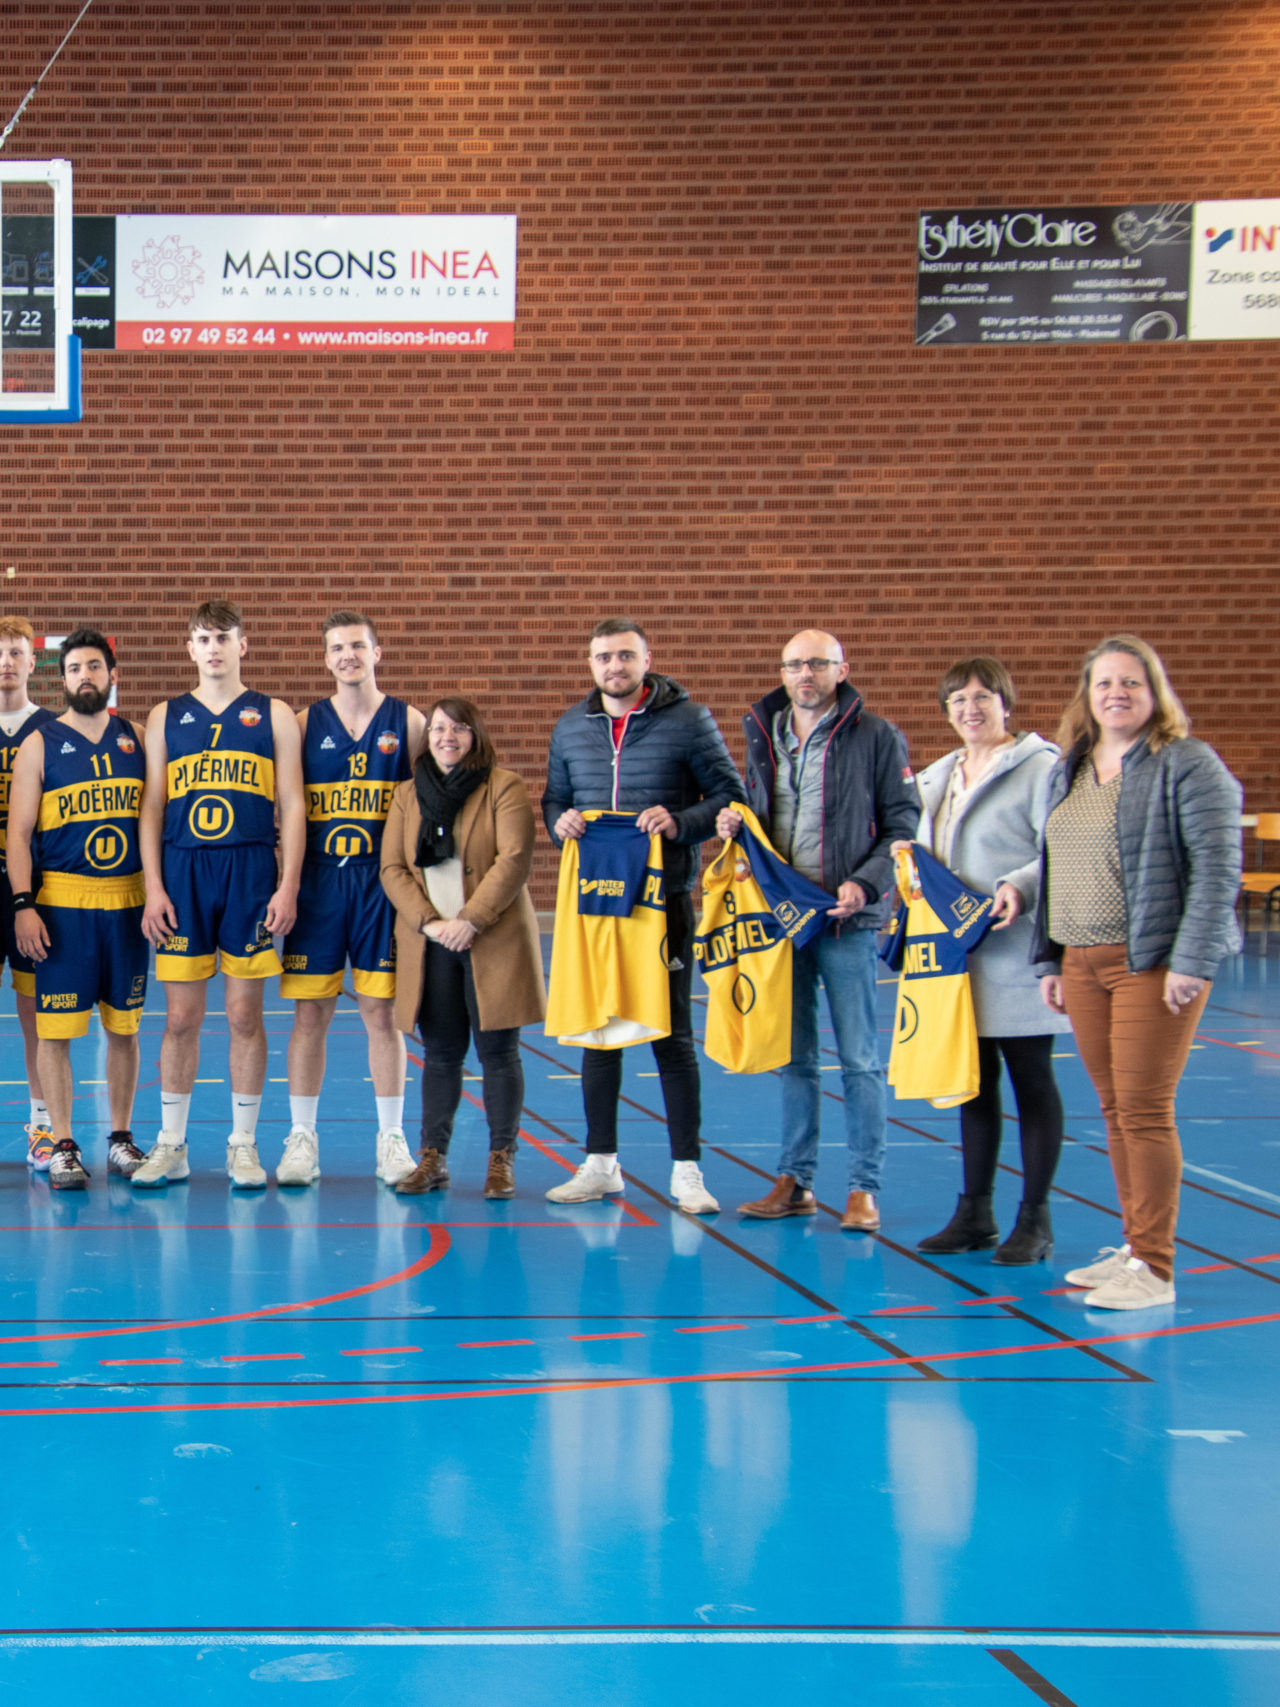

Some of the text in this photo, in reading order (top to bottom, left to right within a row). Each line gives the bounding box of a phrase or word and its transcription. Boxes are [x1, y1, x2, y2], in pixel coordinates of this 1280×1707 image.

[1240, 225, 1280, 252] IN
[223, 249, 499, 280] MAISONS INEA
[1206, 268, 1256, 285] Zone
[222, 286, 249, 296] MA
[377, 286, 422, 297] MON
[437, 286, 501, 297] IDEAL
[1242, 293, 1280, 309] 568
[20, 310, 42, 326] 22
[142, 327, 489, 345] 02 97 49 52 44 www.maisons-inea.fr
[210, 723, 222, 748] 7
[90, 752, 113, 777] 11
[347, 751, 367, 778] 13
[309, 784, 394, 815] PLOËRME
[597, 879, 625, 889] INTER
[597, 887, 624, 897] SPORT
[723, 890, 736, 915] 8
[953, 896, 993, 939] Groupama
[51, 993, 78, 1002] INTER
[51, 1001, 78, 1010] SPORT
